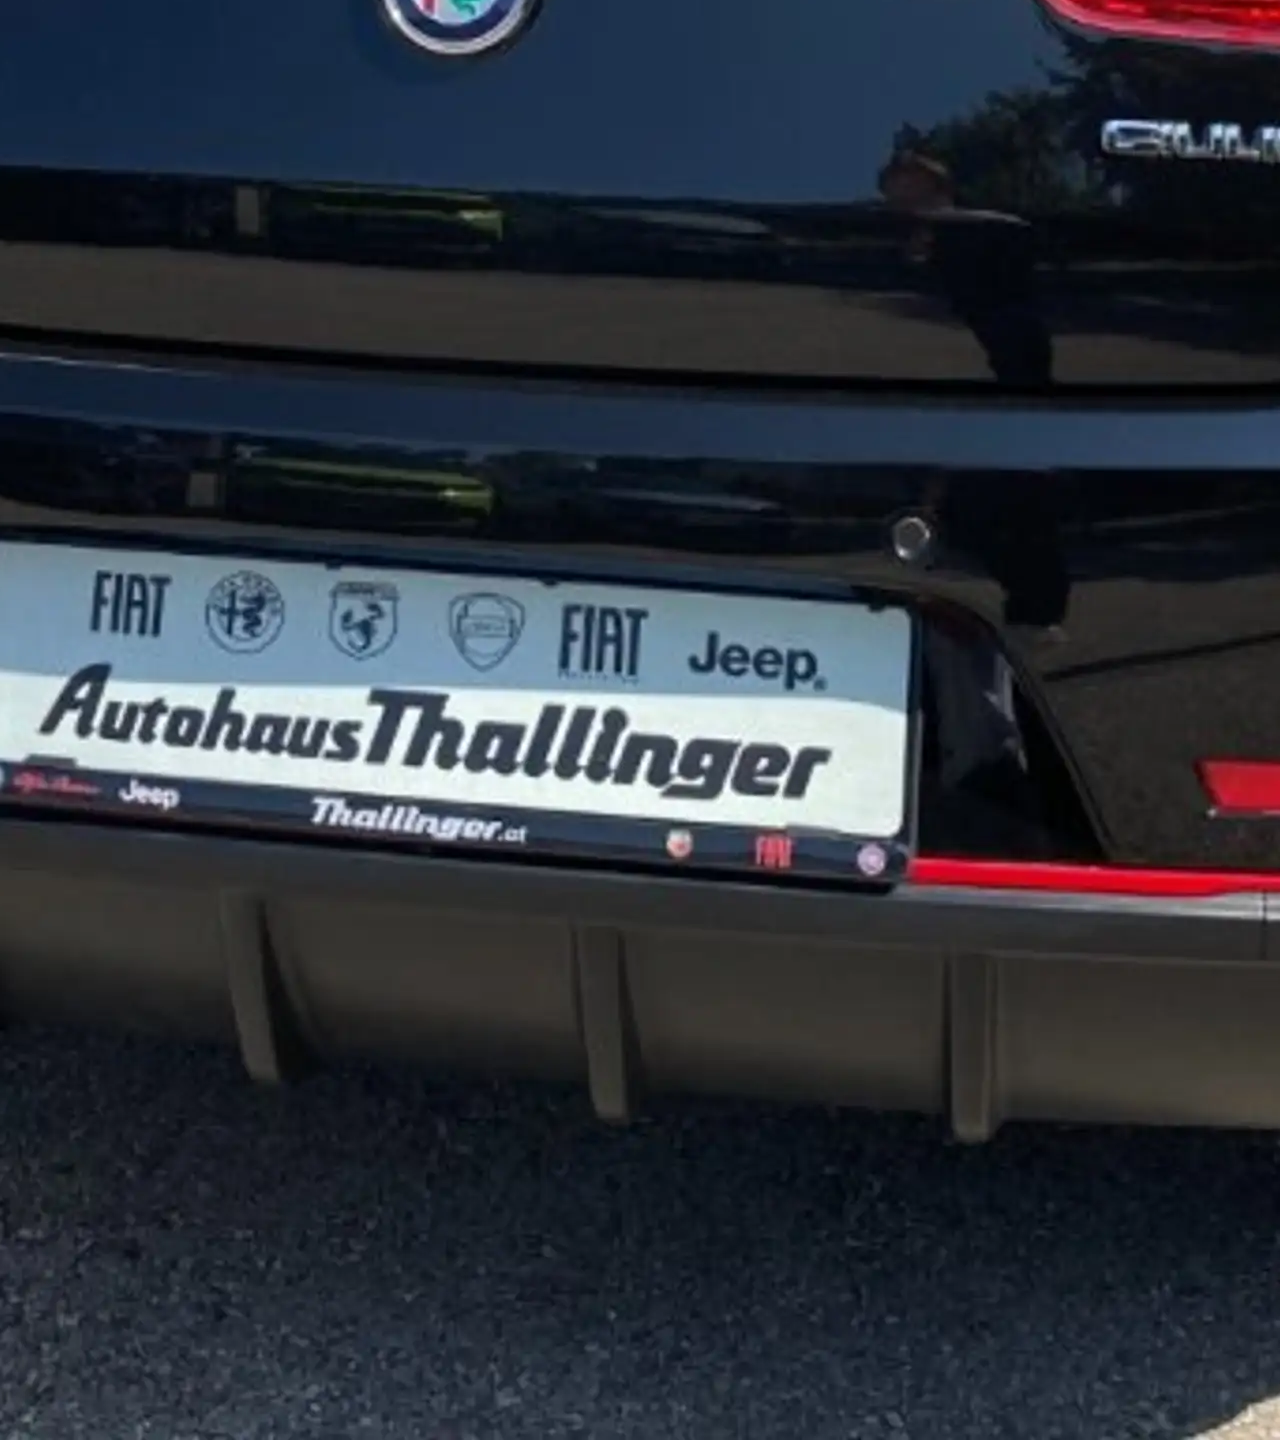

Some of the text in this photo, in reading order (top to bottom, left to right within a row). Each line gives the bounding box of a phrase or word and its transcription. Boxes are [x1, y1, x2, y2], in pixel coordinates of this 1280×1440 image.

[89, 569, 172, 639] FIAT
[558, 603, 650, 676] FIAT
[117, 777, 181, 811] Jeep
